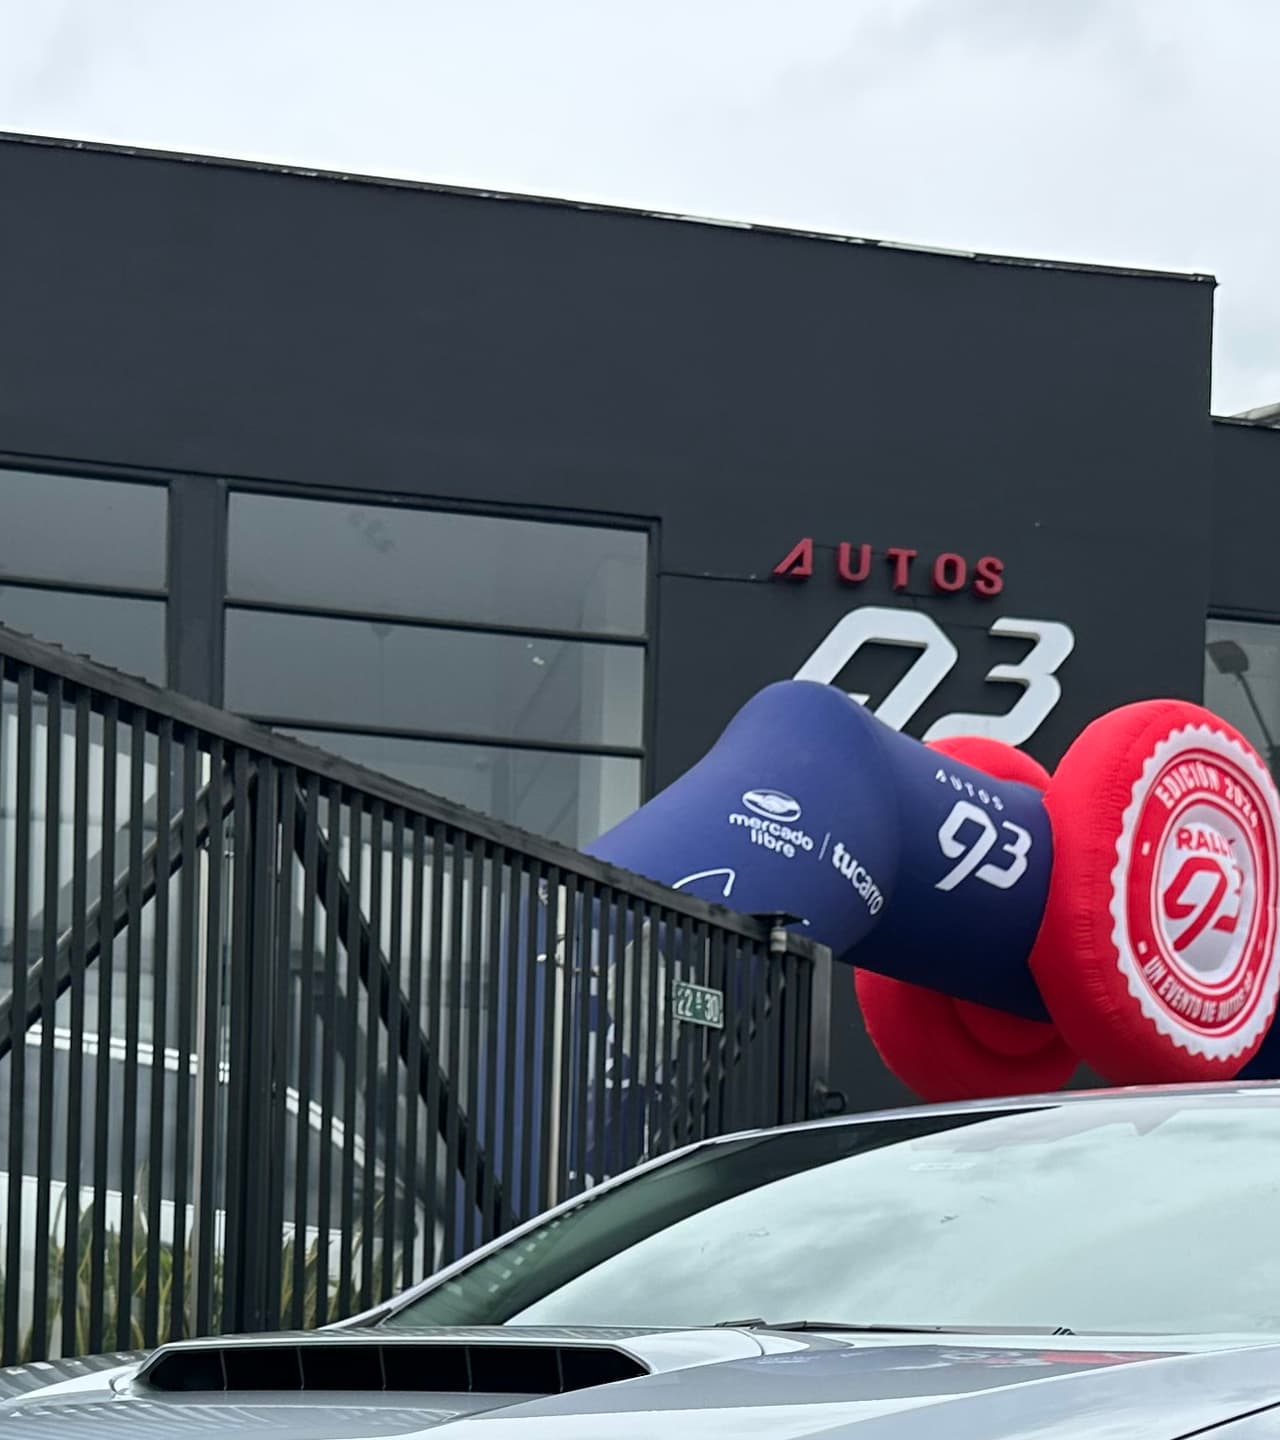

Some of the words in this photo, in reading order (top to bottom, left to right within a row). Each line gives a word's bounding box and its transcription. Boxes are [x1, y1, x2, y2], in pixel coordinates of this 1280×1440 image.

[773, 537, 1005, 598] AUTOS
[729, 813, 814, 851] mercado
[832, 841, 884, 915] tucarro
[750, 828, 795, 858] libre
[934, 800, 1032, 891] 93
[1200, 999, 1218, 1023] DE
